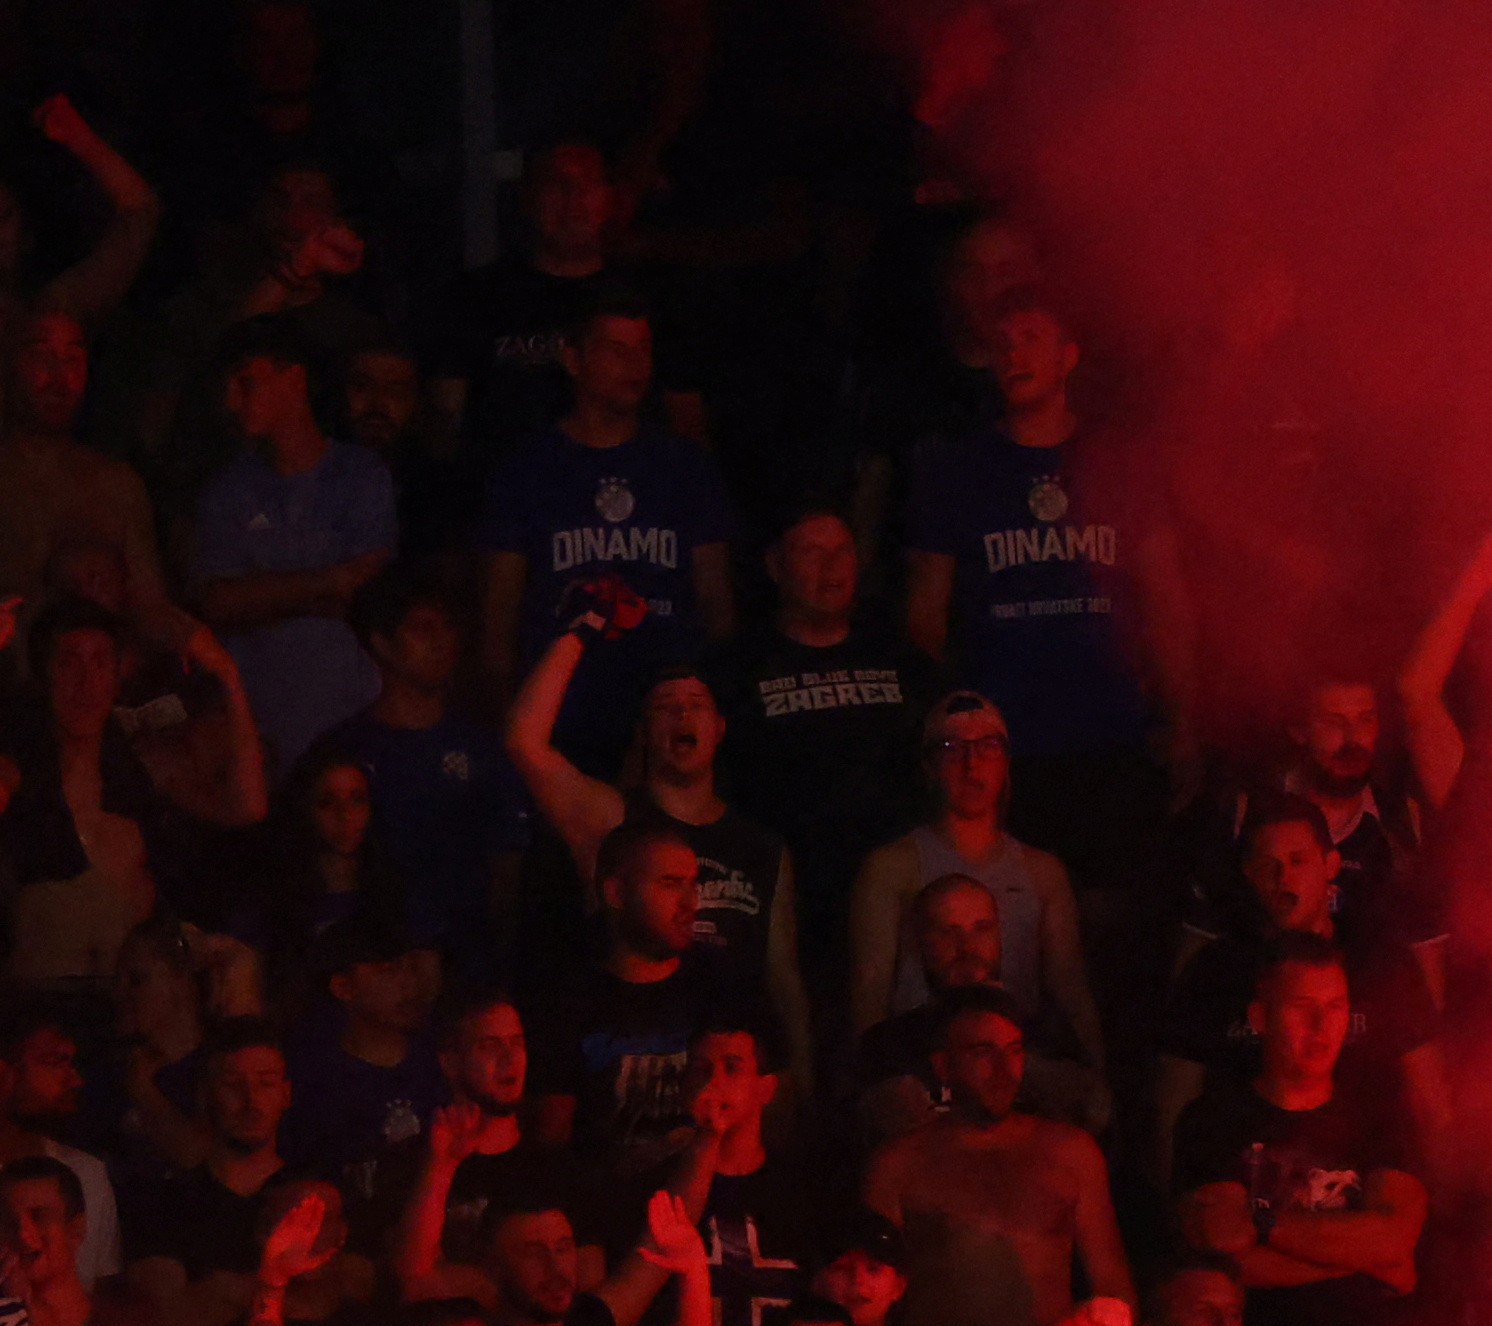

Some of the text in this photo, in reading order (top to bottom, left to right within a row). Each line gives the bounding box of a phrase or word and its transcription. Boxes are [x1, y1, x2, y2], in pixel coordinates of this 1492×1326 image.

[552, 526, 678, 572] DINAMO
[983, 524, 1117, 573] DINAMO
[759, 676, 798, 694] BAD
[763, 682, 904, 718] ZAGREB
